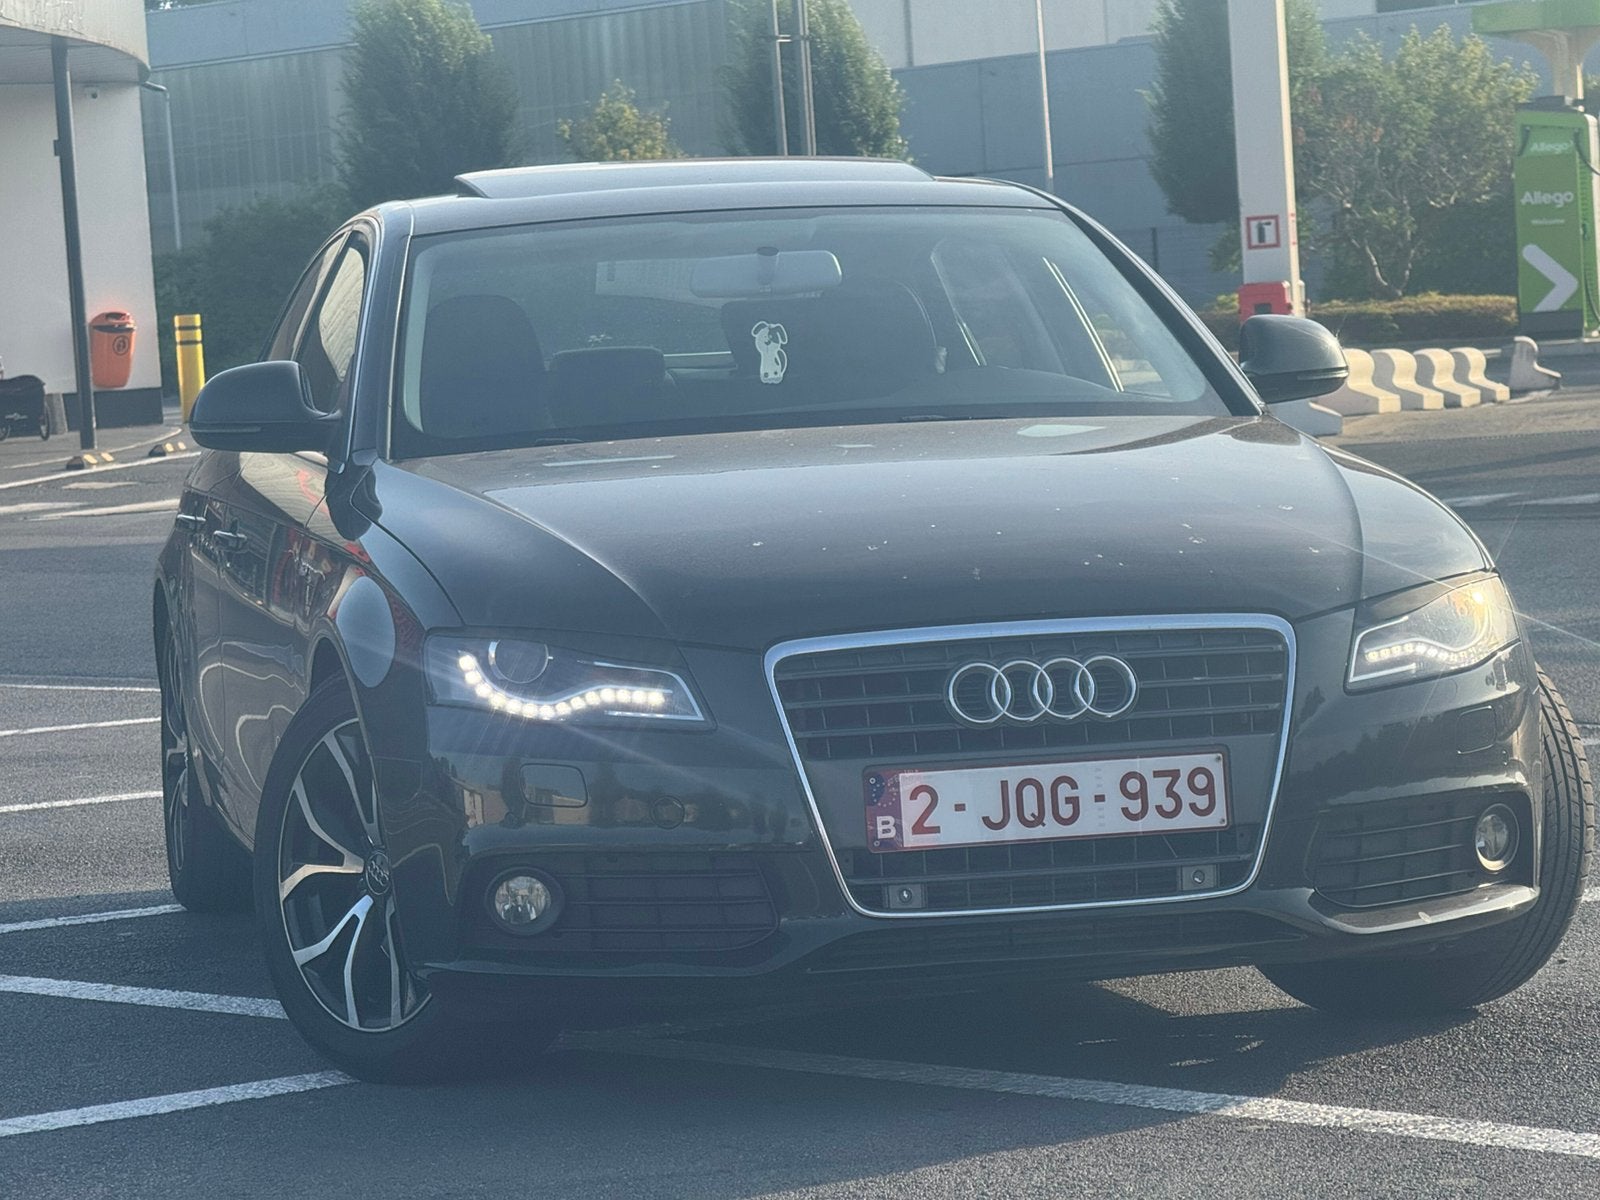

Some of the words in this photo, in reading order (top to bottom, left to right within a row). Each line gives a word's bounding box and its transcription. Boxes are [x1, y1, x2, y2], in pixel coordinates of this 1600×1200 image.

[1530, 142, 1569, 154] Allego
[1520, 190, 1574, 208] Allego
[876, 815, 897, 840] B
[908, 766, 1216, 836] 2-JQG-939
